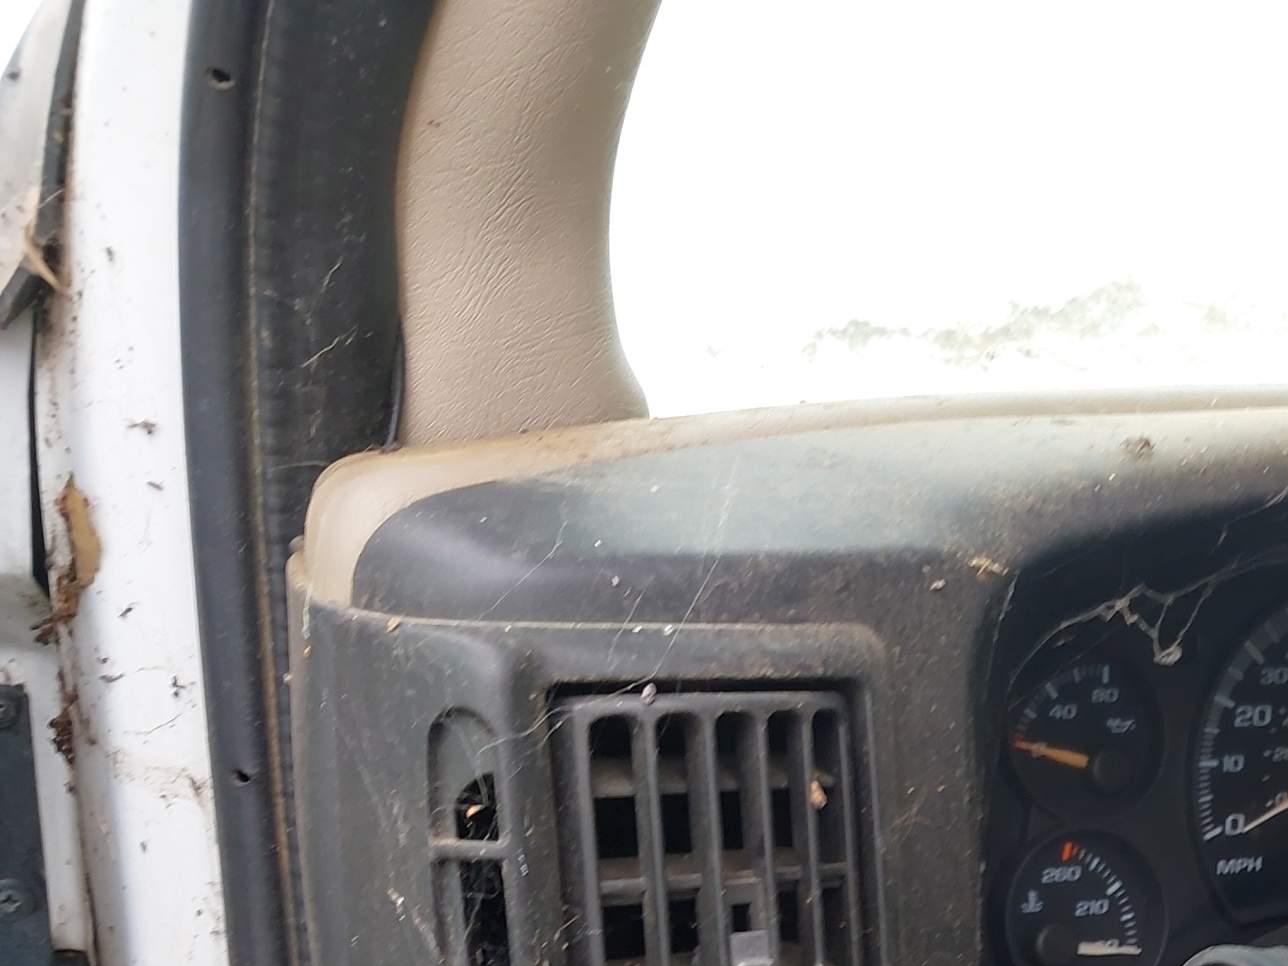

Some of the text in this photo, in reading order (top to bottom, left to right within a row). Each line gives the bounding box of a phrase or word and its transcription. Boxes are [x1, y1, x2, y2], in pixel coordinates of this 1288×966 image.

[1260, 666, 1288, 684] 30
[1049, 703, 1078, 720] 40
[1234, 704, 1272, 728] 20
[1222, 754, 1245, 773] 10
[1223, 814, 1246, 837] 0
[1041, 866, 1082, 884] 260
[1216, 856, 1263, 876] MPH
[1074, 899, 1110, 918] 210
